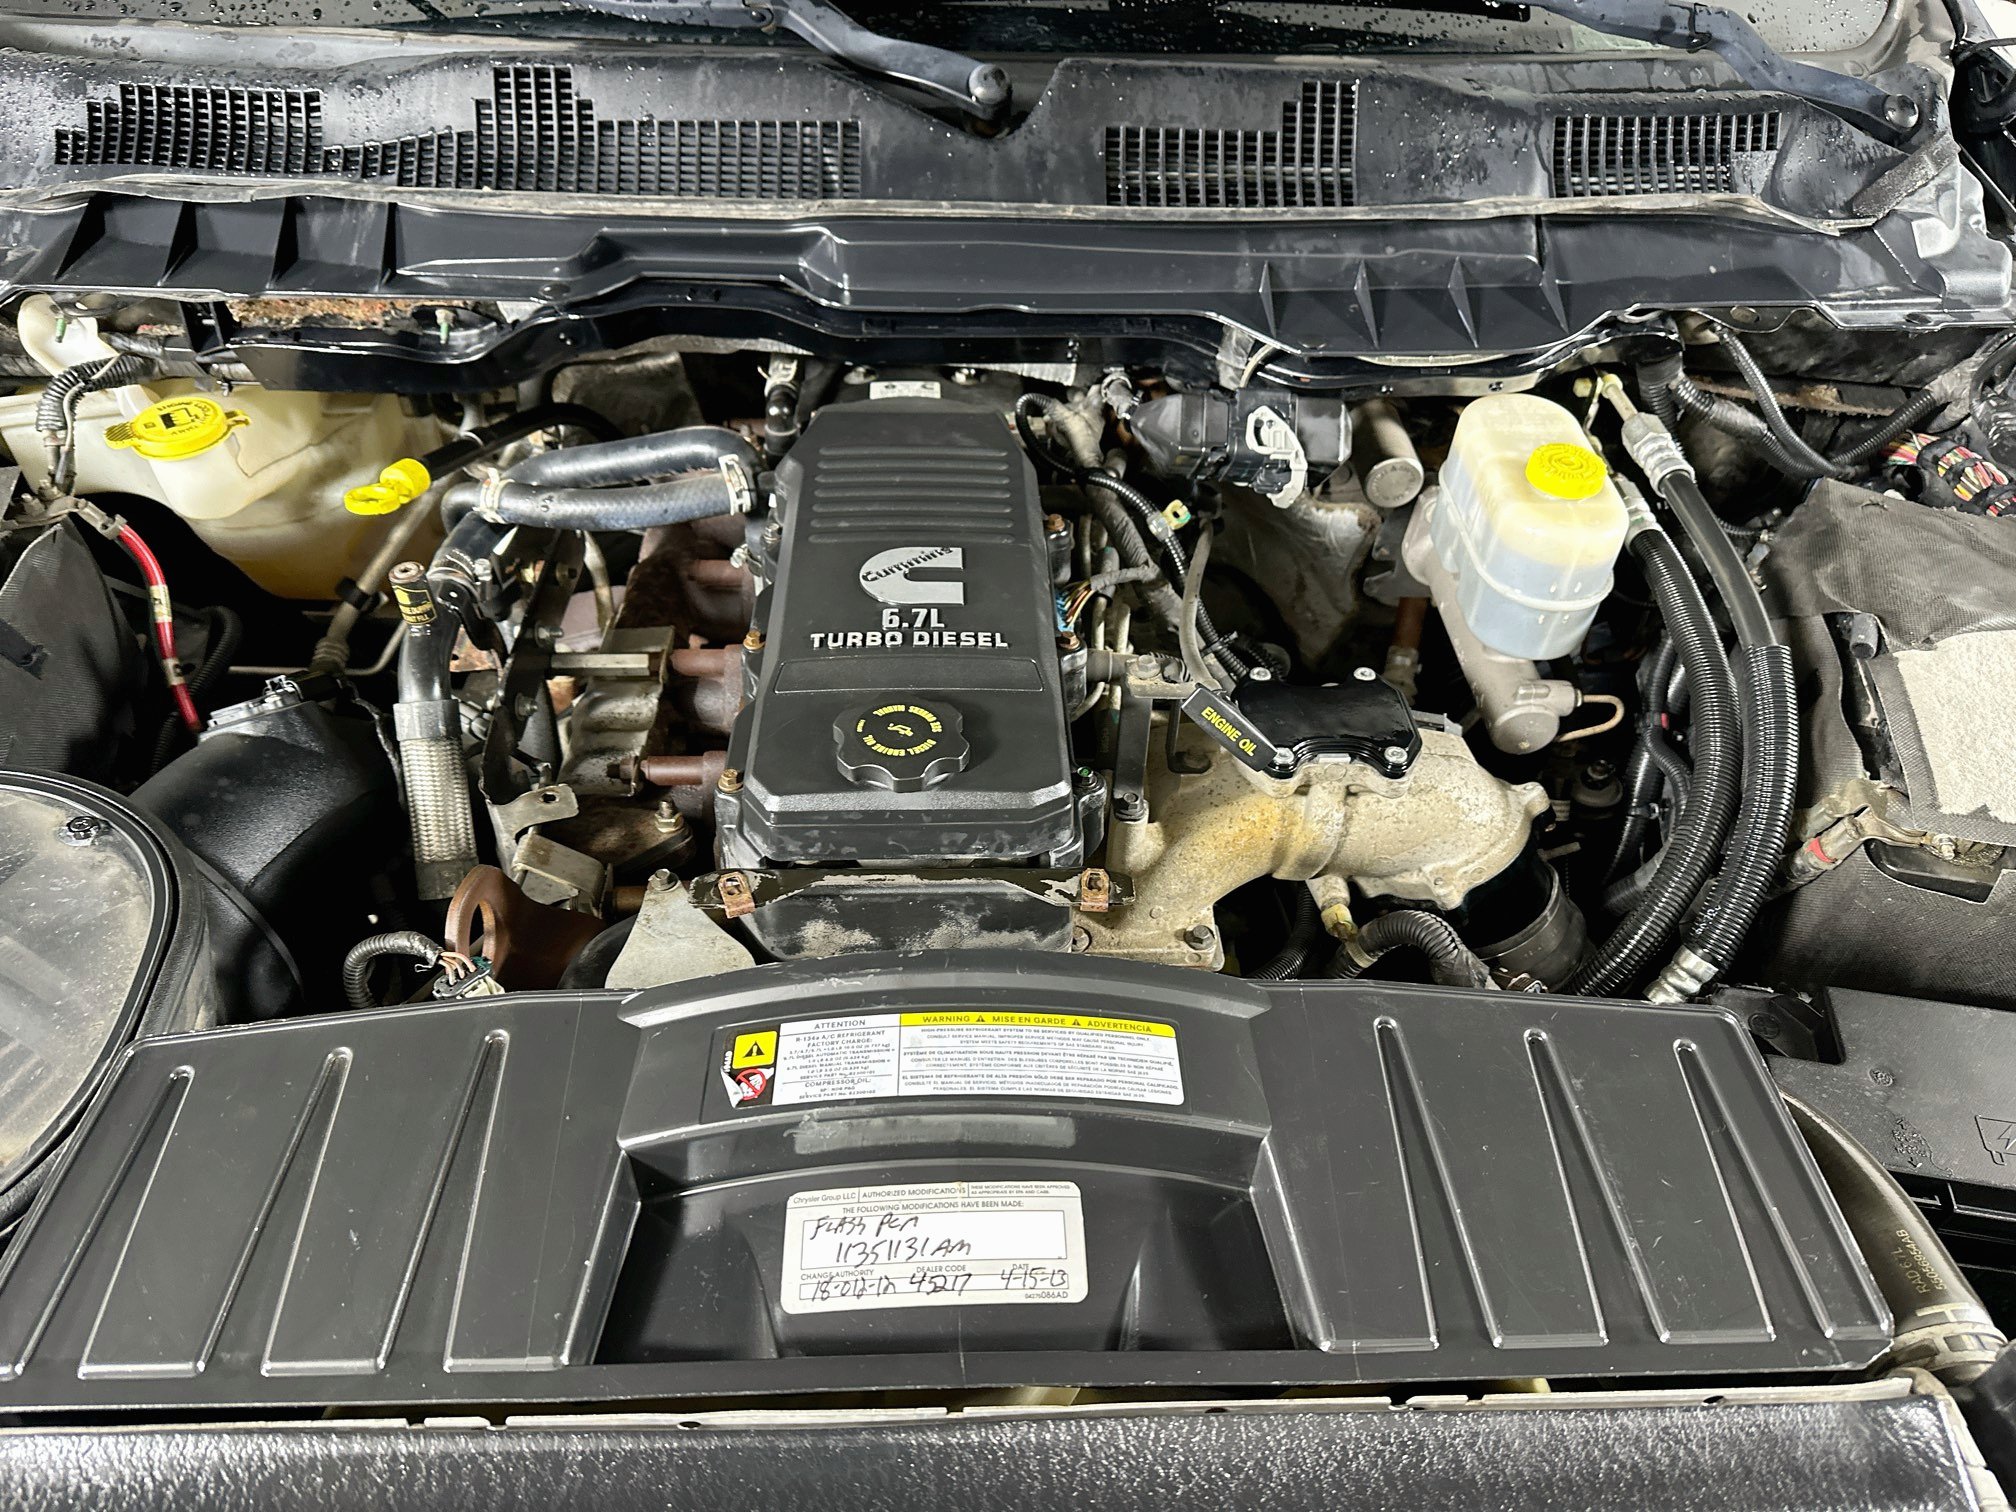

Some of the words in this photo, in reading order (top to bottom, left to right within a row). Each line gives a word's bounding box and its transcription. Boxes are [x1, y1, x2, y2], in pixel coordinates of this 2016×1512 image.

[882, 608, 945, 630] 6.7L
[810, 631, 903, 649] TURBO
[912, 631, 1009, 649] DIESEL
[1200, 706, 1242, 742] ENGINE
[1238, 737, 1257, 757] OIL
[814, 1019, 866, 1030] ATTENTION
[922, 1015, 970, 1023] WARNING
[992, 1015, 1016, 1023] MISE
[1033, 1017, 1066, 1025] GARDE
[1087, 1020, 1153, 1033] ADVERTENCIA
[836, 1030, 886, 1038] REFRIGERANT
[793, 1195, 820, 1205] Chrysler
[821, 1194, 841, 1202] Group
[842, 1192, 856, 1200] LLC
[862, 1189, 906, 1198] AUTHORIZED
[907, 1187, 966, 1196] MODIFICATIONS
[856, 1204, 900, 1214] FOLLOWING
[901, 1202, 959, 1211] MODIFICATIONS
[961, 1200, 980, 1208] HAVE
[1896, 1229, 1947, 1290] 55056954AB
[916, 1265, 943, 1273] DEALER
[944, 1264, 966, 1272] CODE
[1012, 1263, 1029, 1271] DATE
[800, 1273, 833, 1281] CHANGE
[834, 1269, 875, 1278] AUTHORITY
[1906, 1270, 1931, 1293] RAD
